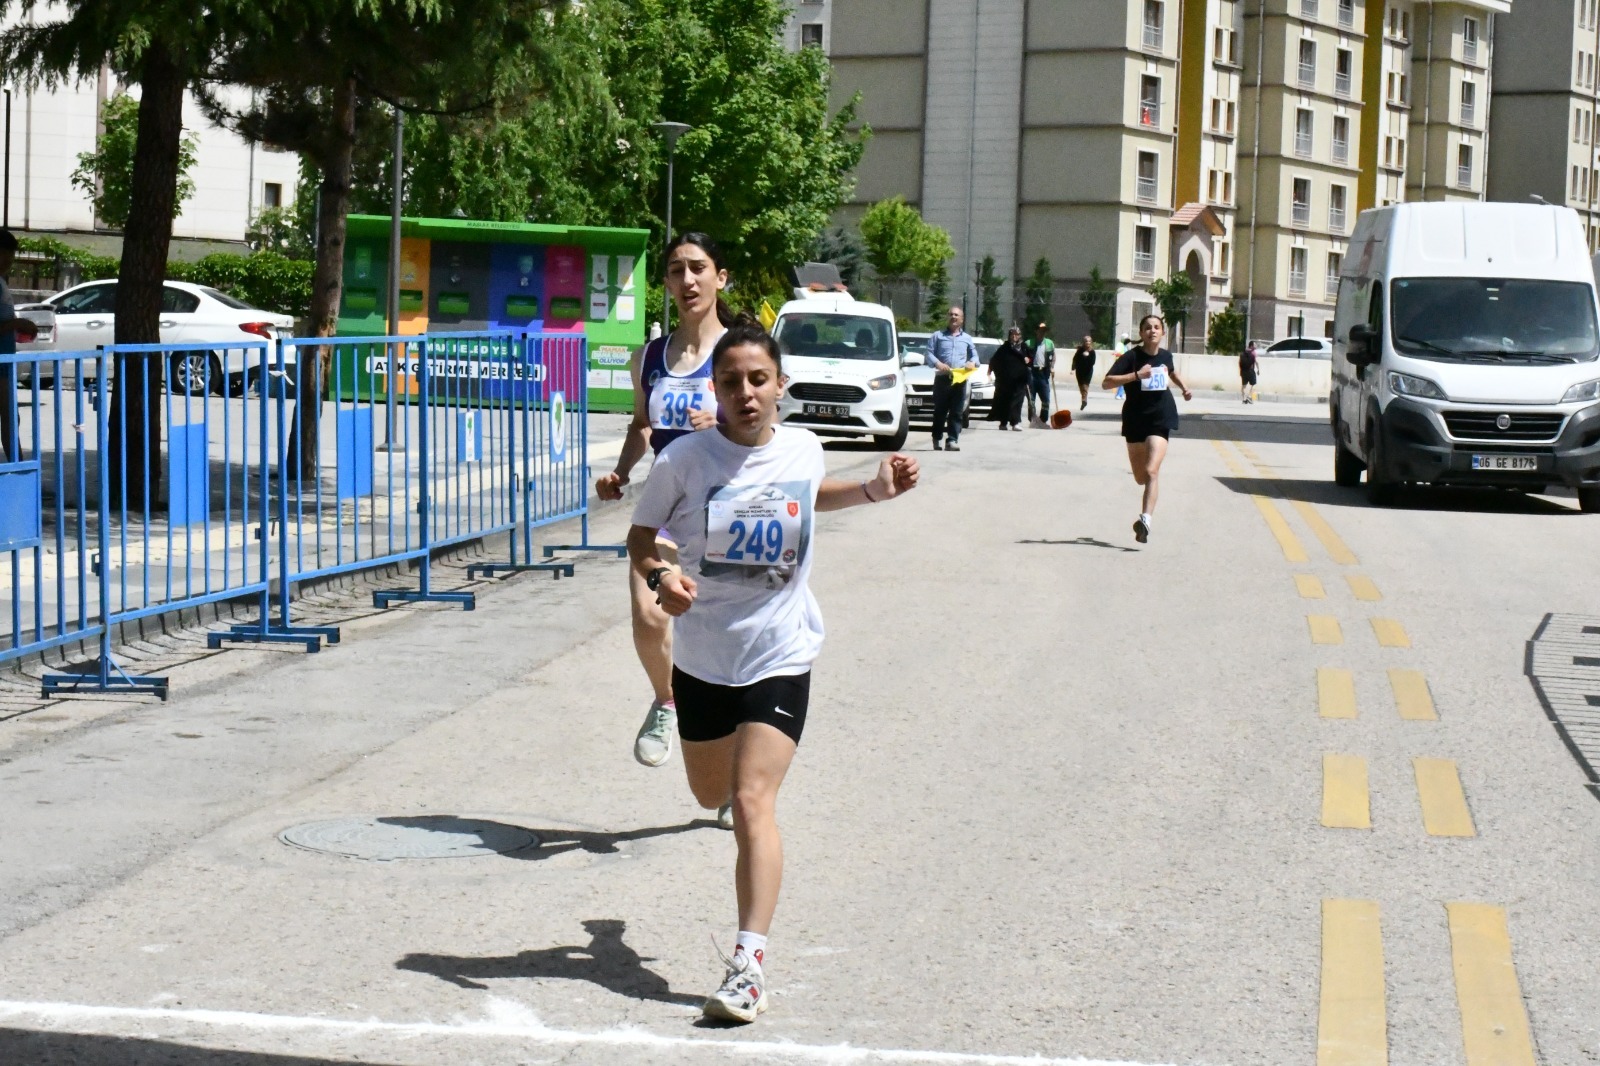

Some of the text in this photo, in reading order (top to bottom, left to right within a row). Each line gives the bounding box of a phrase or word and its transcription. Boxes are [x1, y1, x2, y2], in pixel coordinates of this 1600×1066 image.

[1148, 374, 1165, 389] 250
[807, 405, 816, 413] 06
[819, 406, 832, 414] CLE
[1479, 457, 1490, 467] 06
[1496, 457, 1508, 468] GE
[726, 520, 783, 562] 249
